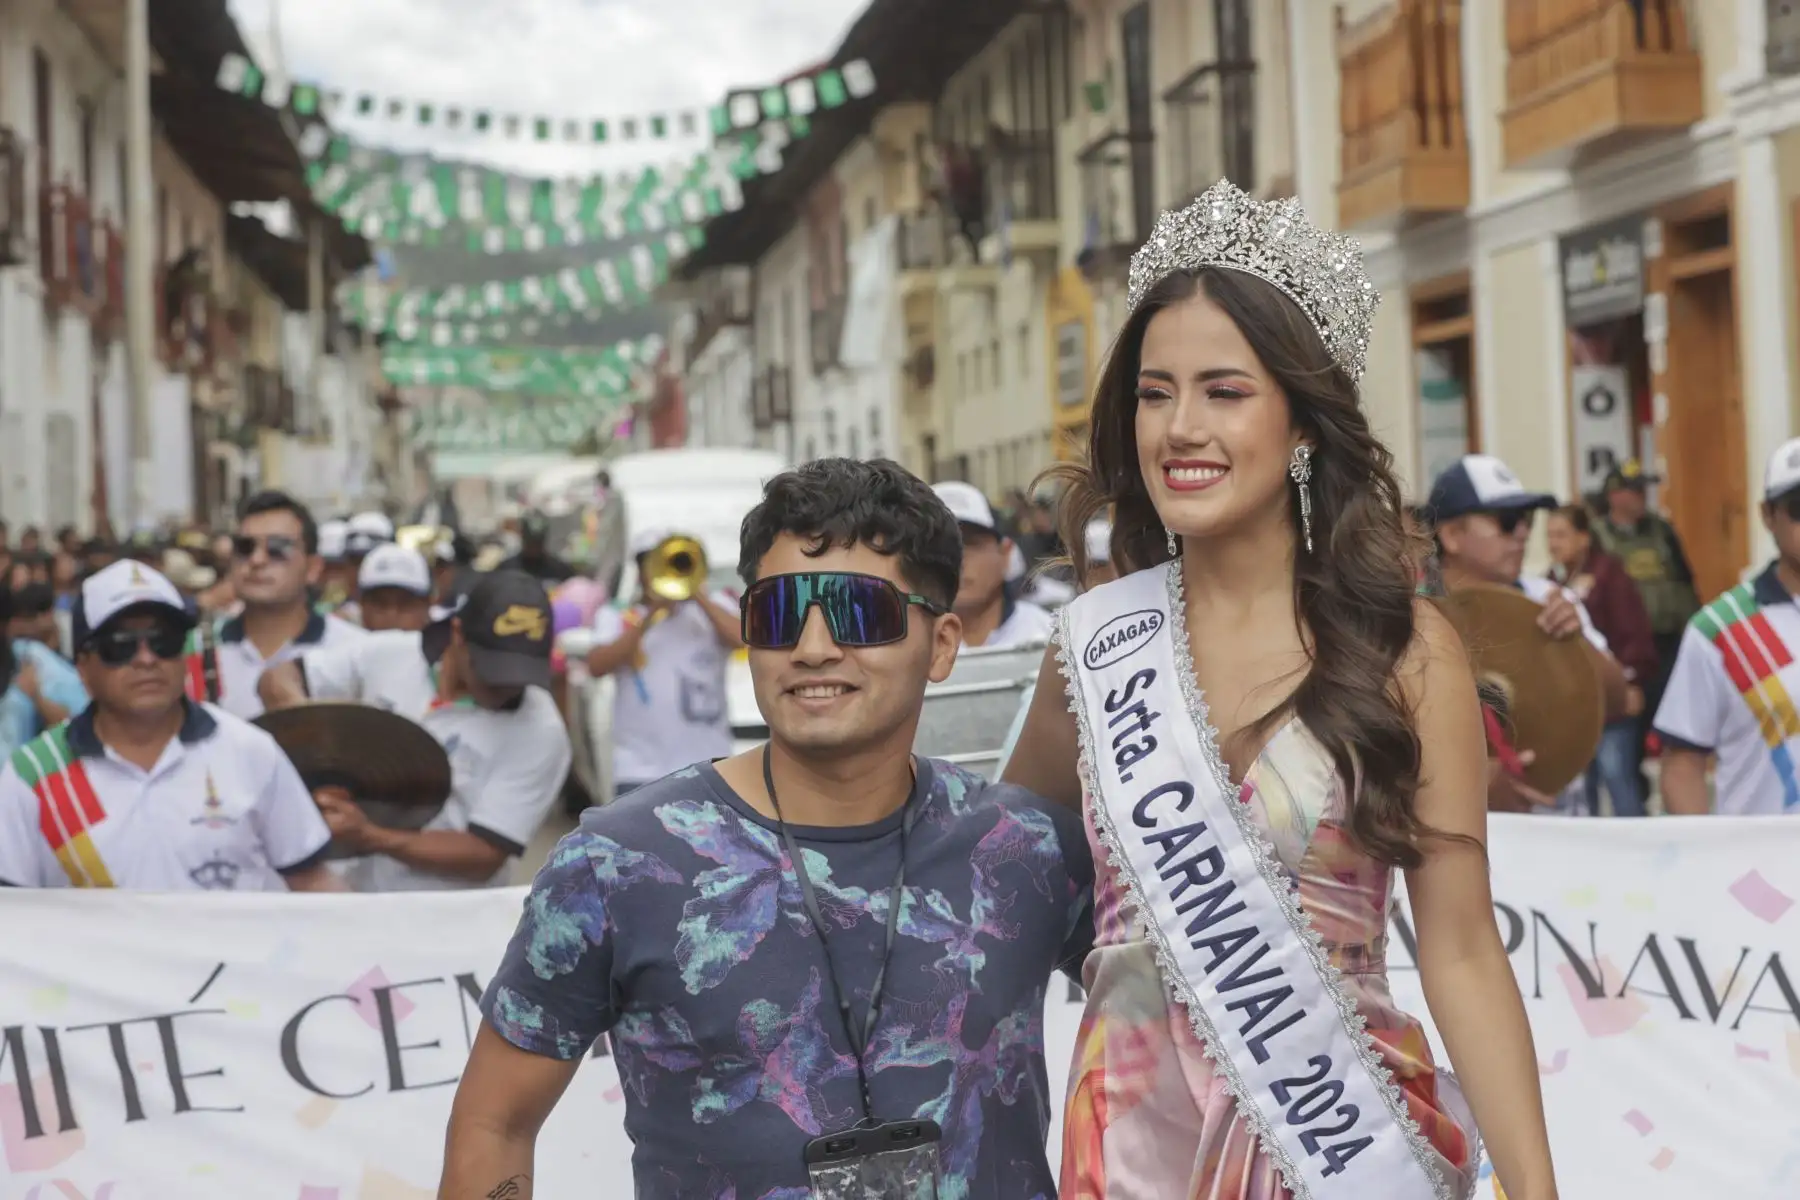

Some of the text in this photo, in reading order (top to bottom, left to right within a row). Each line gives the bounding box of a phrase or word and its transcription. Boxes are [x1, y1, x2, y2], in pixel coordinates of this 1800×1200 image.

[1089, 615, 1160, 664] CAXAGAS
[1104, 667, 1375, 1178] Srta. CARNAVAL 2024
